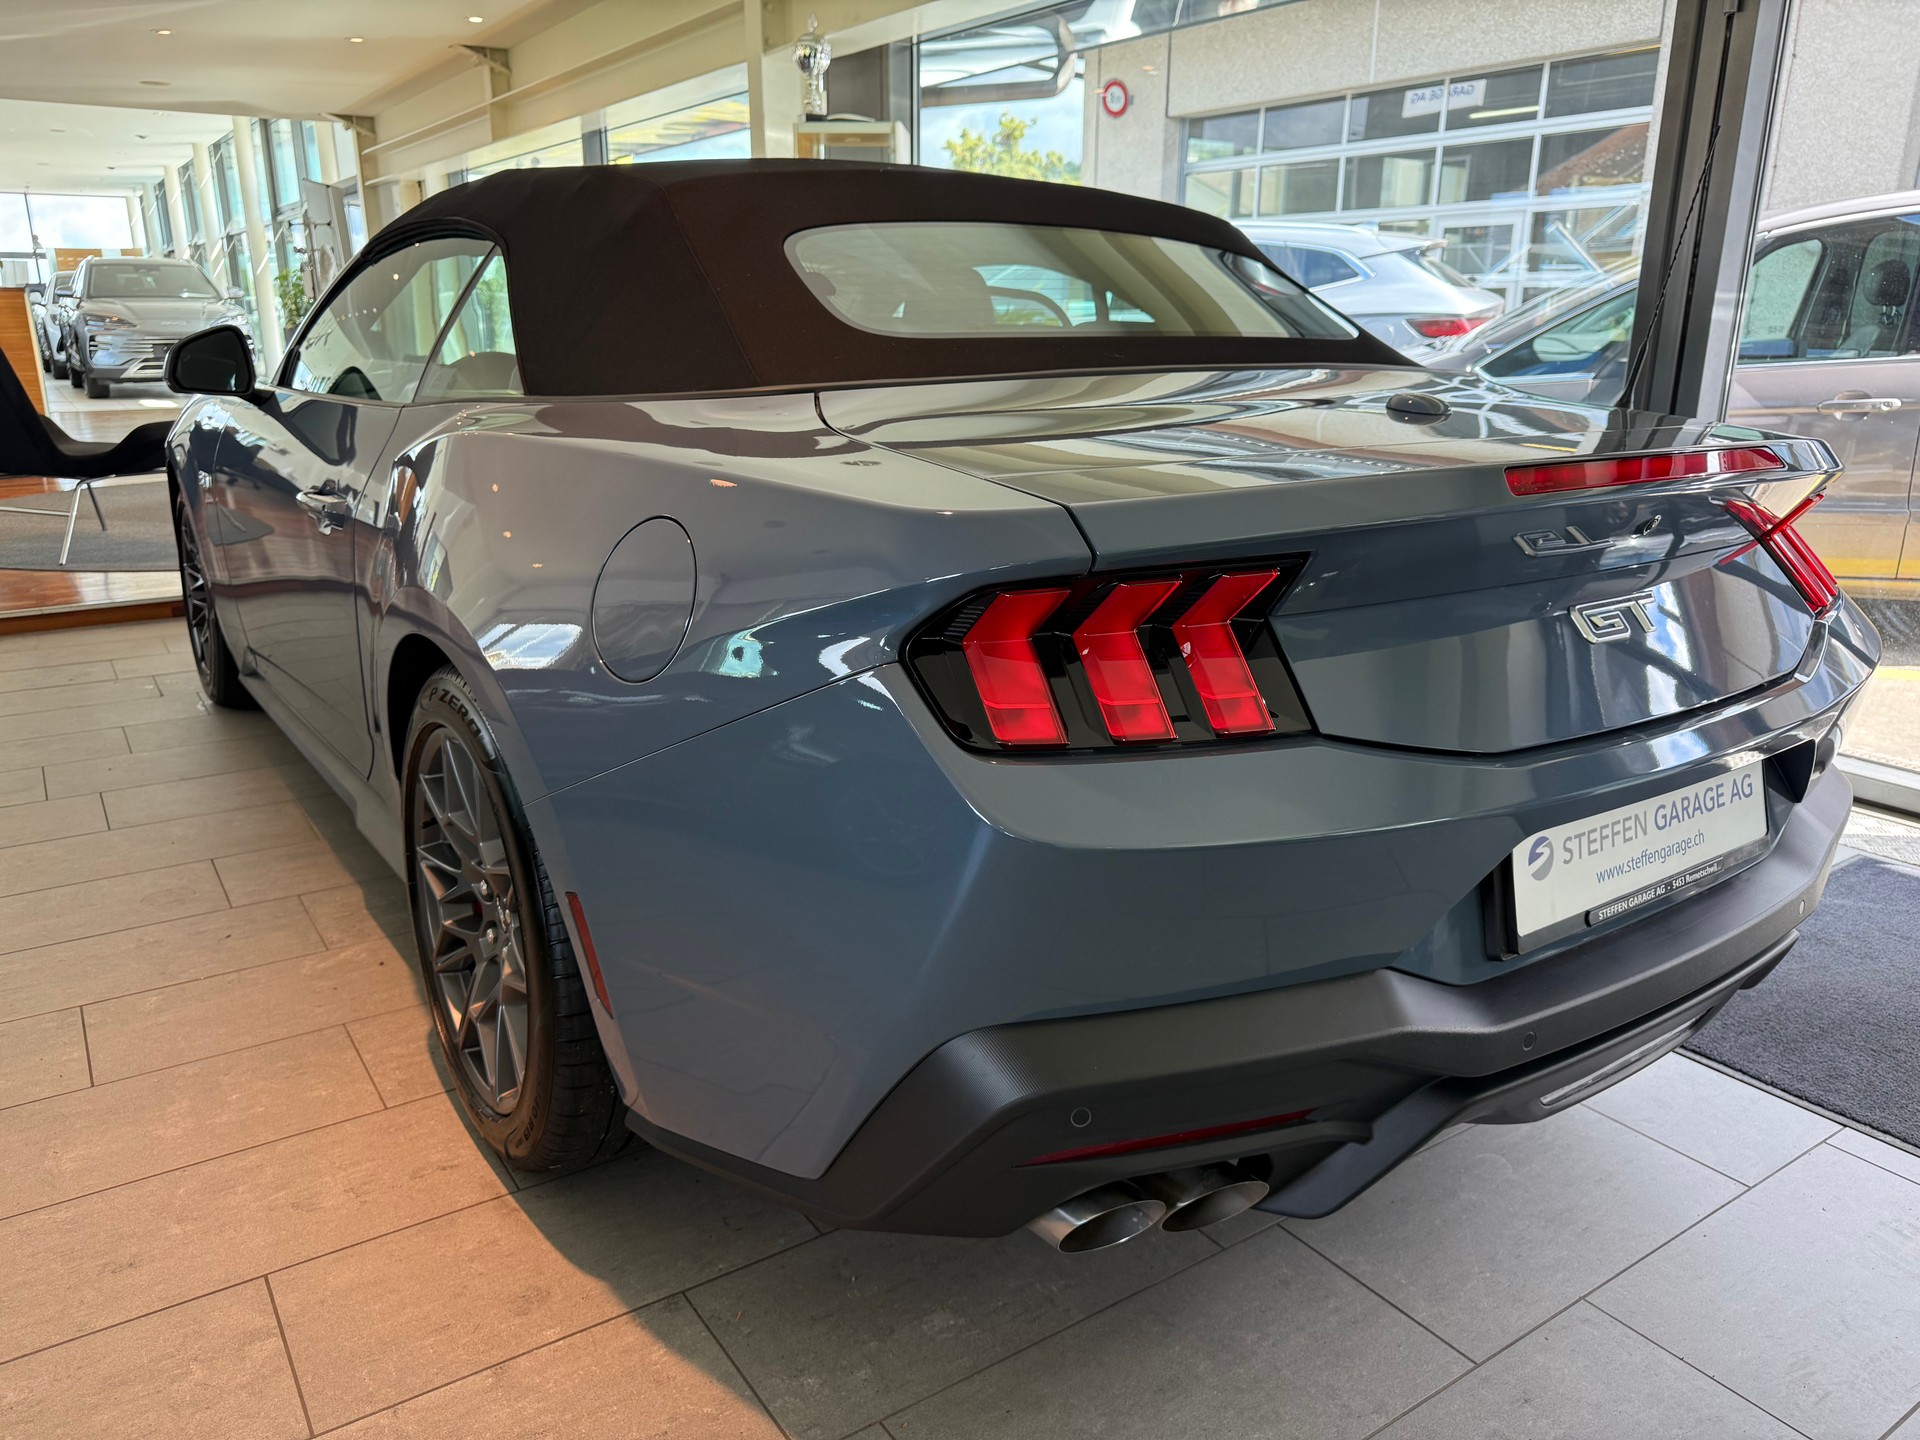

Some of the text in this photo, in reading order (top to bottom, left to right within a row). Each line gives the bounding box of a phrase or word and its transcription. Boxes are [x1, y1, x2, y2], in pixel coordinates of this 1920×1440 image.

[1569, 590, 1657, 644] GT
[438, 689, 481, 738] ZERO
[1562, 773, 1754, 865] STEFFEN GARAGE AG
[1595, 829, 1705, 884] www.steffengarage.ch
[1598, 900, 1628, 920] STEFFEN
[1628, 888, 1656, 908] GARAGE
[1655, 884, 1666, 897] AG
[1672, 876, 1685, 889] 5453
